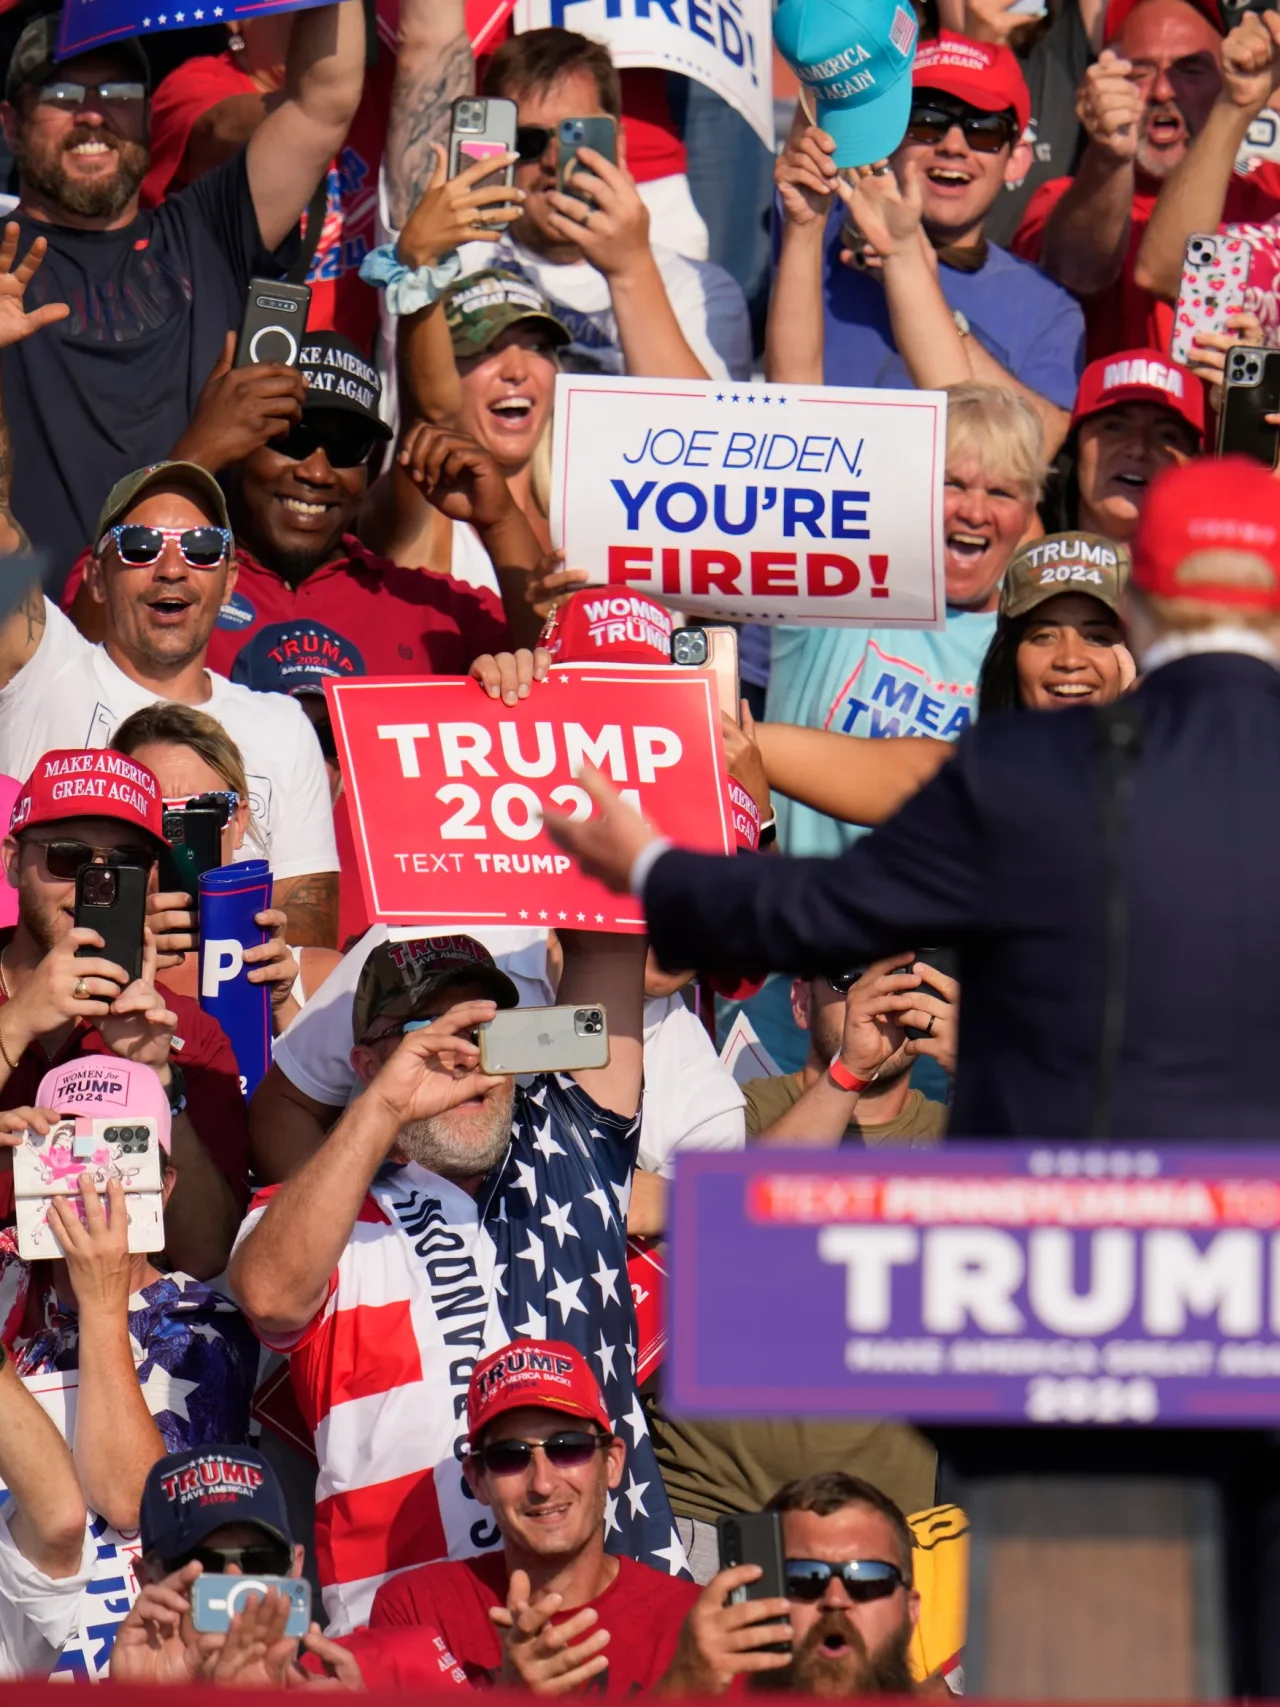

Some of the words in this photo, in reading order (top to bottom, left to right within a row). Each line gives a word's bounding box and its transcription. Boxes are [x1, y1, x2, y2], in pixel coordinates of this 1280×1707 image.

[825, 68, 876, 100] AGAIN
[299, 346, 322, 364] KE
[323, 347, 380, 391] AMERICA
[1103, 358, 1184, 398] MAGA
[334, 377, 375, 409] AGAIN
[622, 428, 719, 466] JOE
[722, 431, 865, 478] BIDEN,
[610, 478, 871, 540] YOU'RE
[1027, 540, 1117, 568] TRUMP
[608, 545, 890, 598] FIRED!
[1039, 566, 1103, 585] 2024
[582, 597, 671, 635] WOMEN
[267, 634, 354, 673] TRUMP
[296, 655, 329, 666] 2024
[871, 672, 971, 737] MEA
[376, 721, 684, 784] TRUMP
[44, 754, 94, 779] MAKE
[94, 756, 157, 800] AMERICA
[52, 777, 109, 801] GREAT
[109, 778, 149, 818] AGAIN
[393, 852, 465, 874] TEXT
[474, 853, 572, 875] TRUMP
[387, 935, 489, 969] TRUMP
[411, 952, 437, 969] SAVE
[57, 1079, 123, 1099] TRUMP
[62, 1069, 104, 1085] WOMEN
[104, 1071, 120, 1081] for
[66, 1092, 104, 1104] 2024
[477, 1352, 575, 1395] TRUMP
[543, 1373, 572, 1388] BACK!
[161, 1461, 264, 1502] TRUMP
[181, 1487, 205, 1505] SAVE
[199, 1491, 238, 1507] 2024
